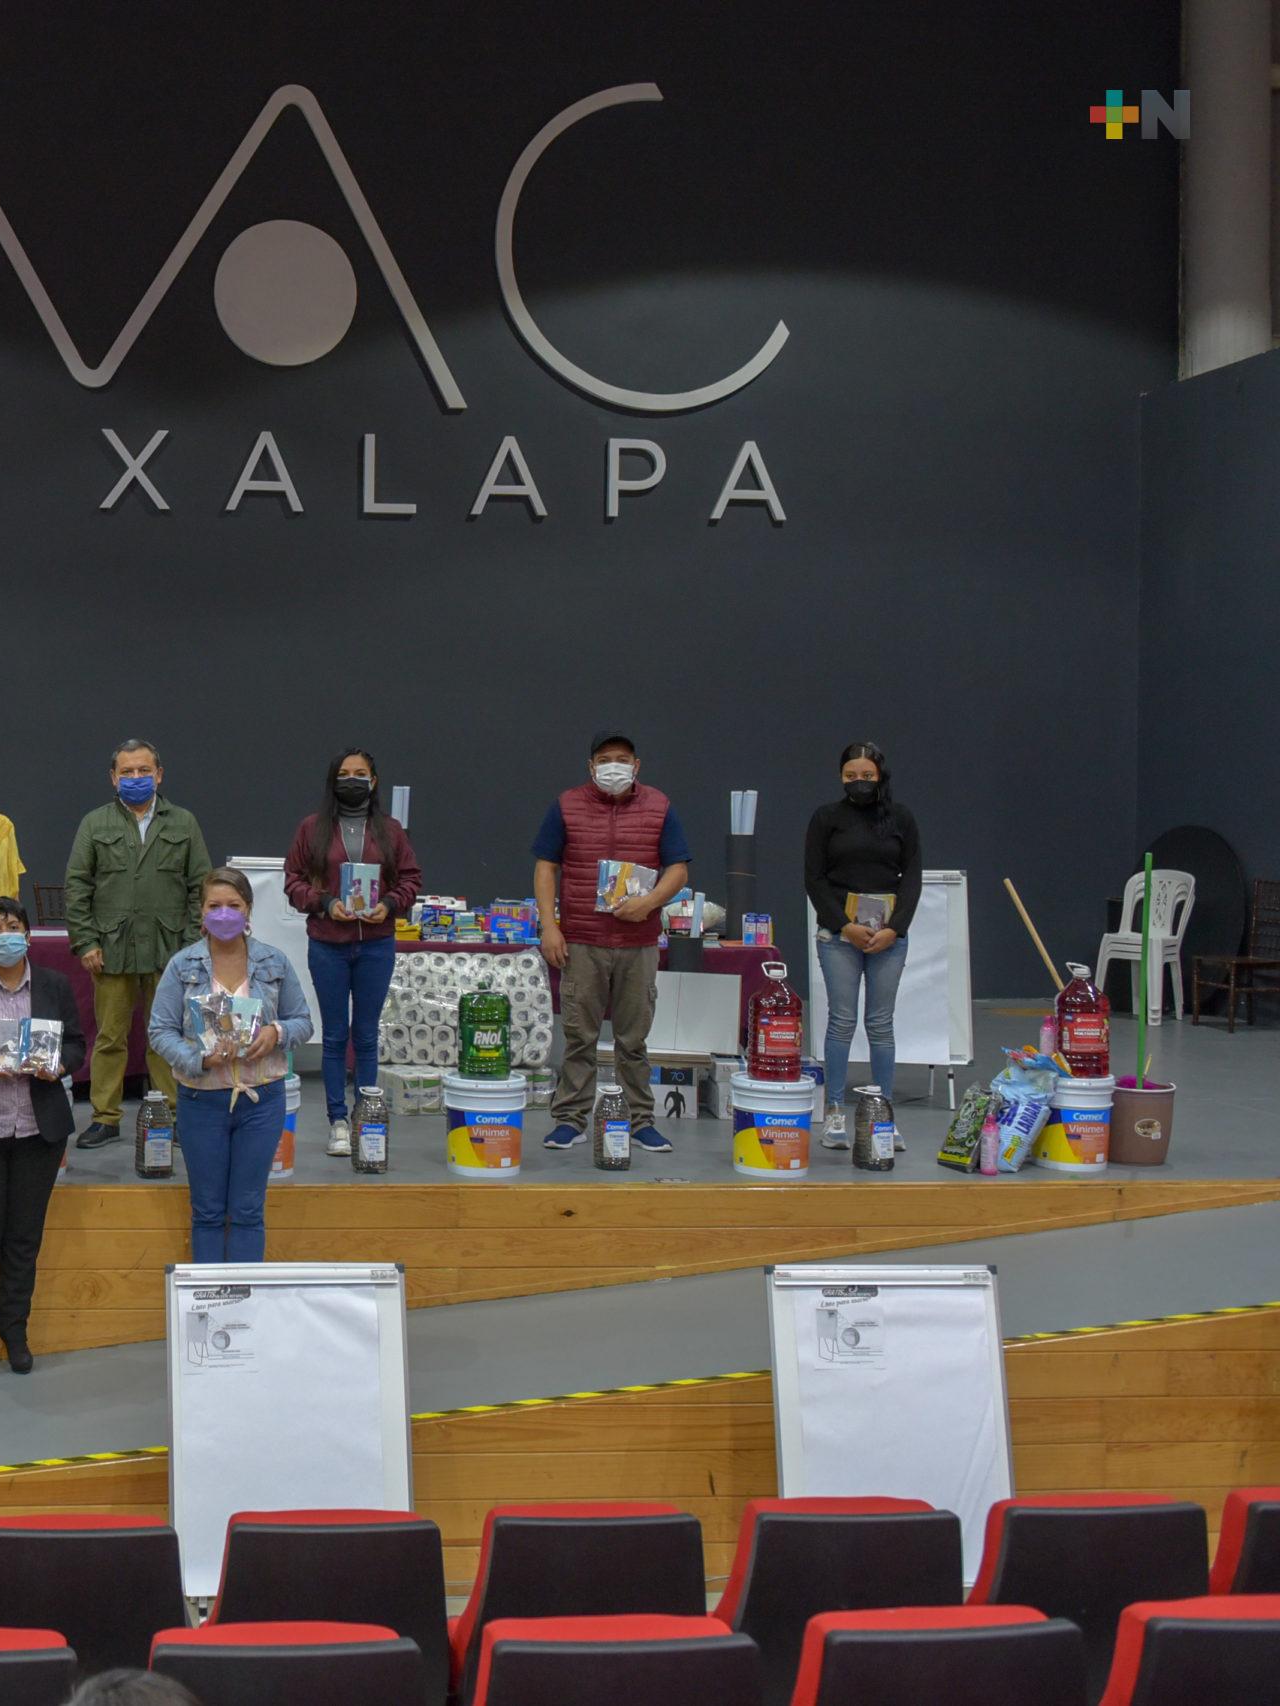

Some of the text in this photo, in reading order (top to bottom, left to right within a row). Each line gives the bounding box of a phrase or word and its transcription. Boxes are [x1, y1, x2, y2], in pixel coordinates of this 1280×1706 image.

[100, 428, 788, 523] XALAPA
[475, 1114, 510, 1124] Comex
[765, 1116, 800, 1126] Comex
[1015, 1101, 1043, 1135] LARIAN
[1073, 1112, 1105, 1121] Comex
[472, 1127, 510, 1137] Vinimex
[761, 1129, 800, 1139] Vinimex
